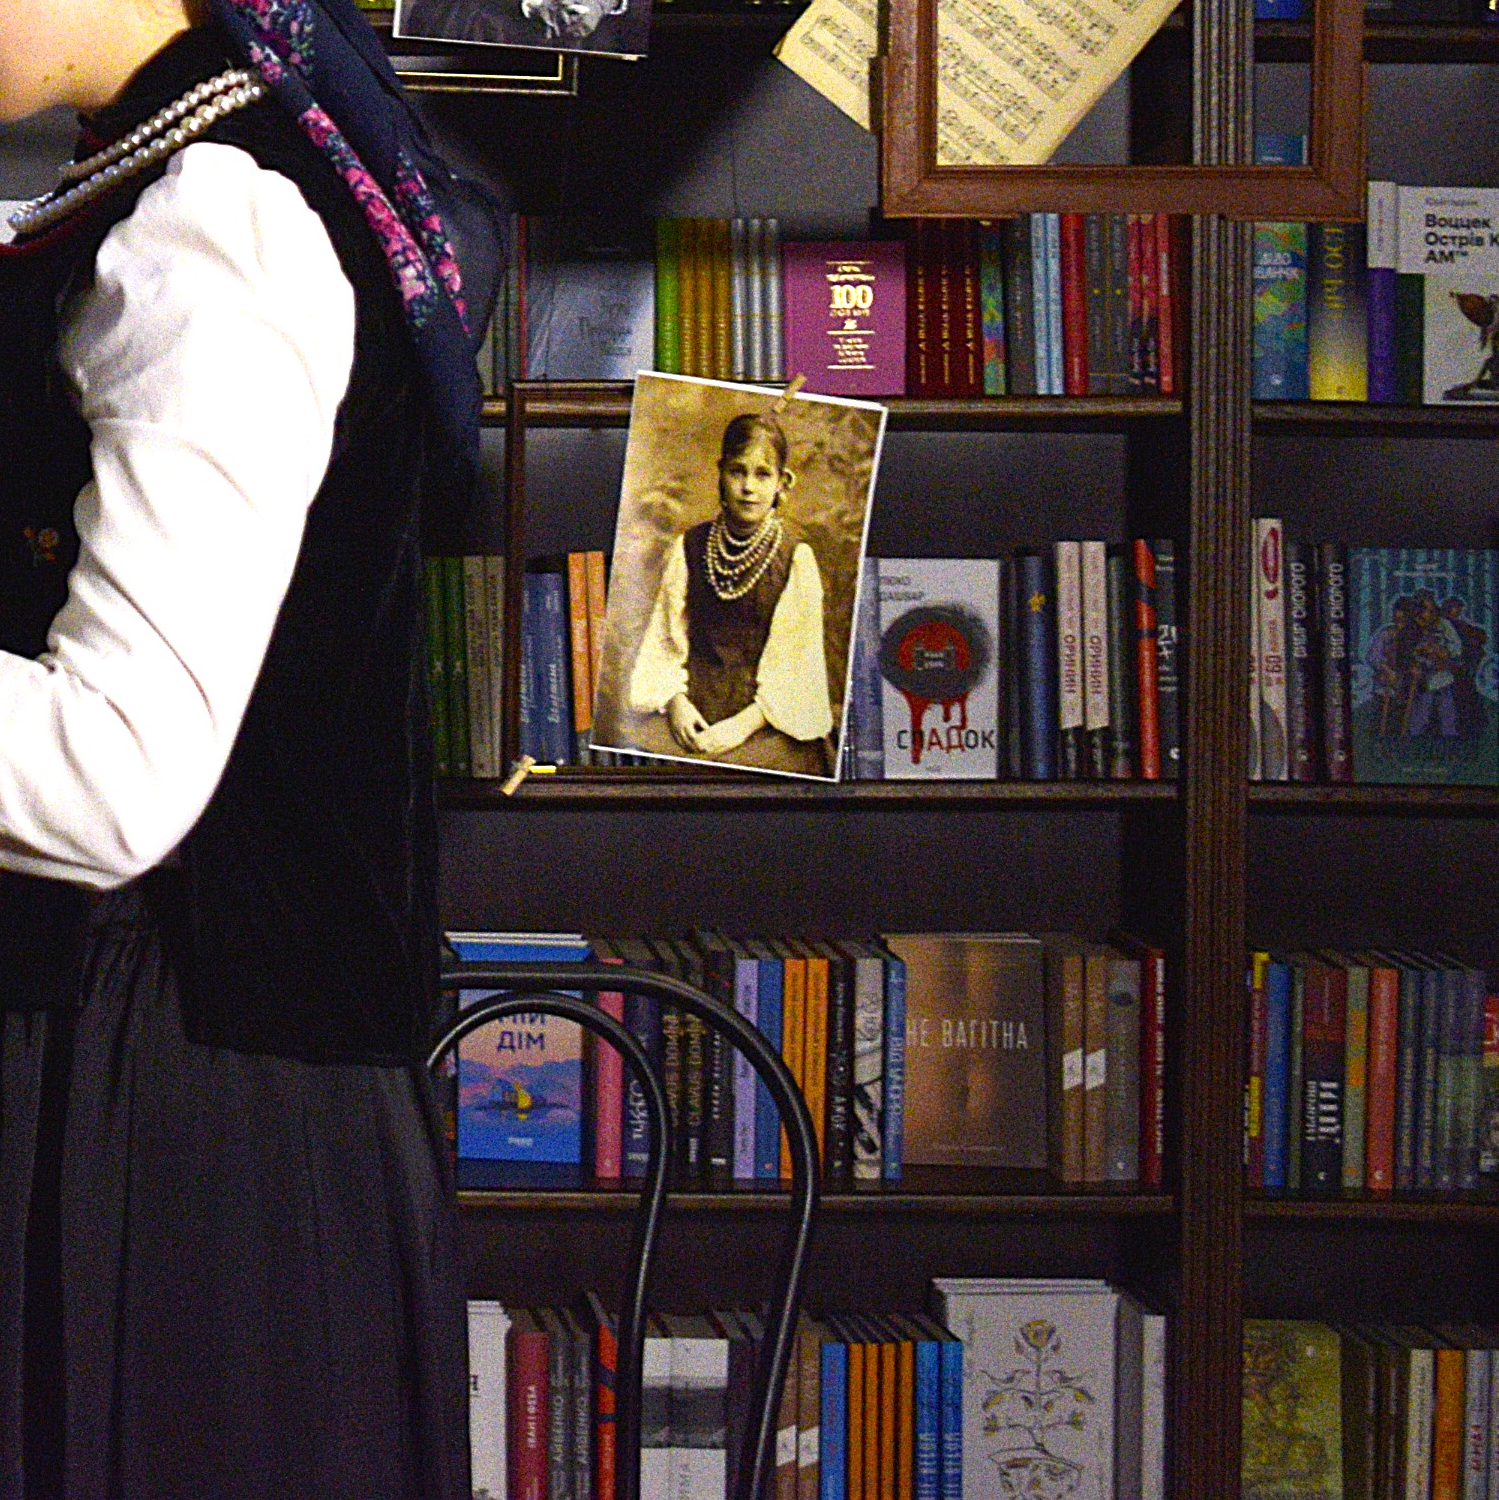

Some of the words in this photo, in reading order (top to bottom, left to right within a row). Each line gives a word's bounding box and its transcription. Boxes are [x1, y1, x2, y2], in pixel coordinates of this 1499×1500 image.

[1424, 213, 1491, 230] Воццек
[1424, 232, 1485, 248] Острів
[829, 283, 874, 309] 100
[496, 1030, 546, 1052] ДІМ
